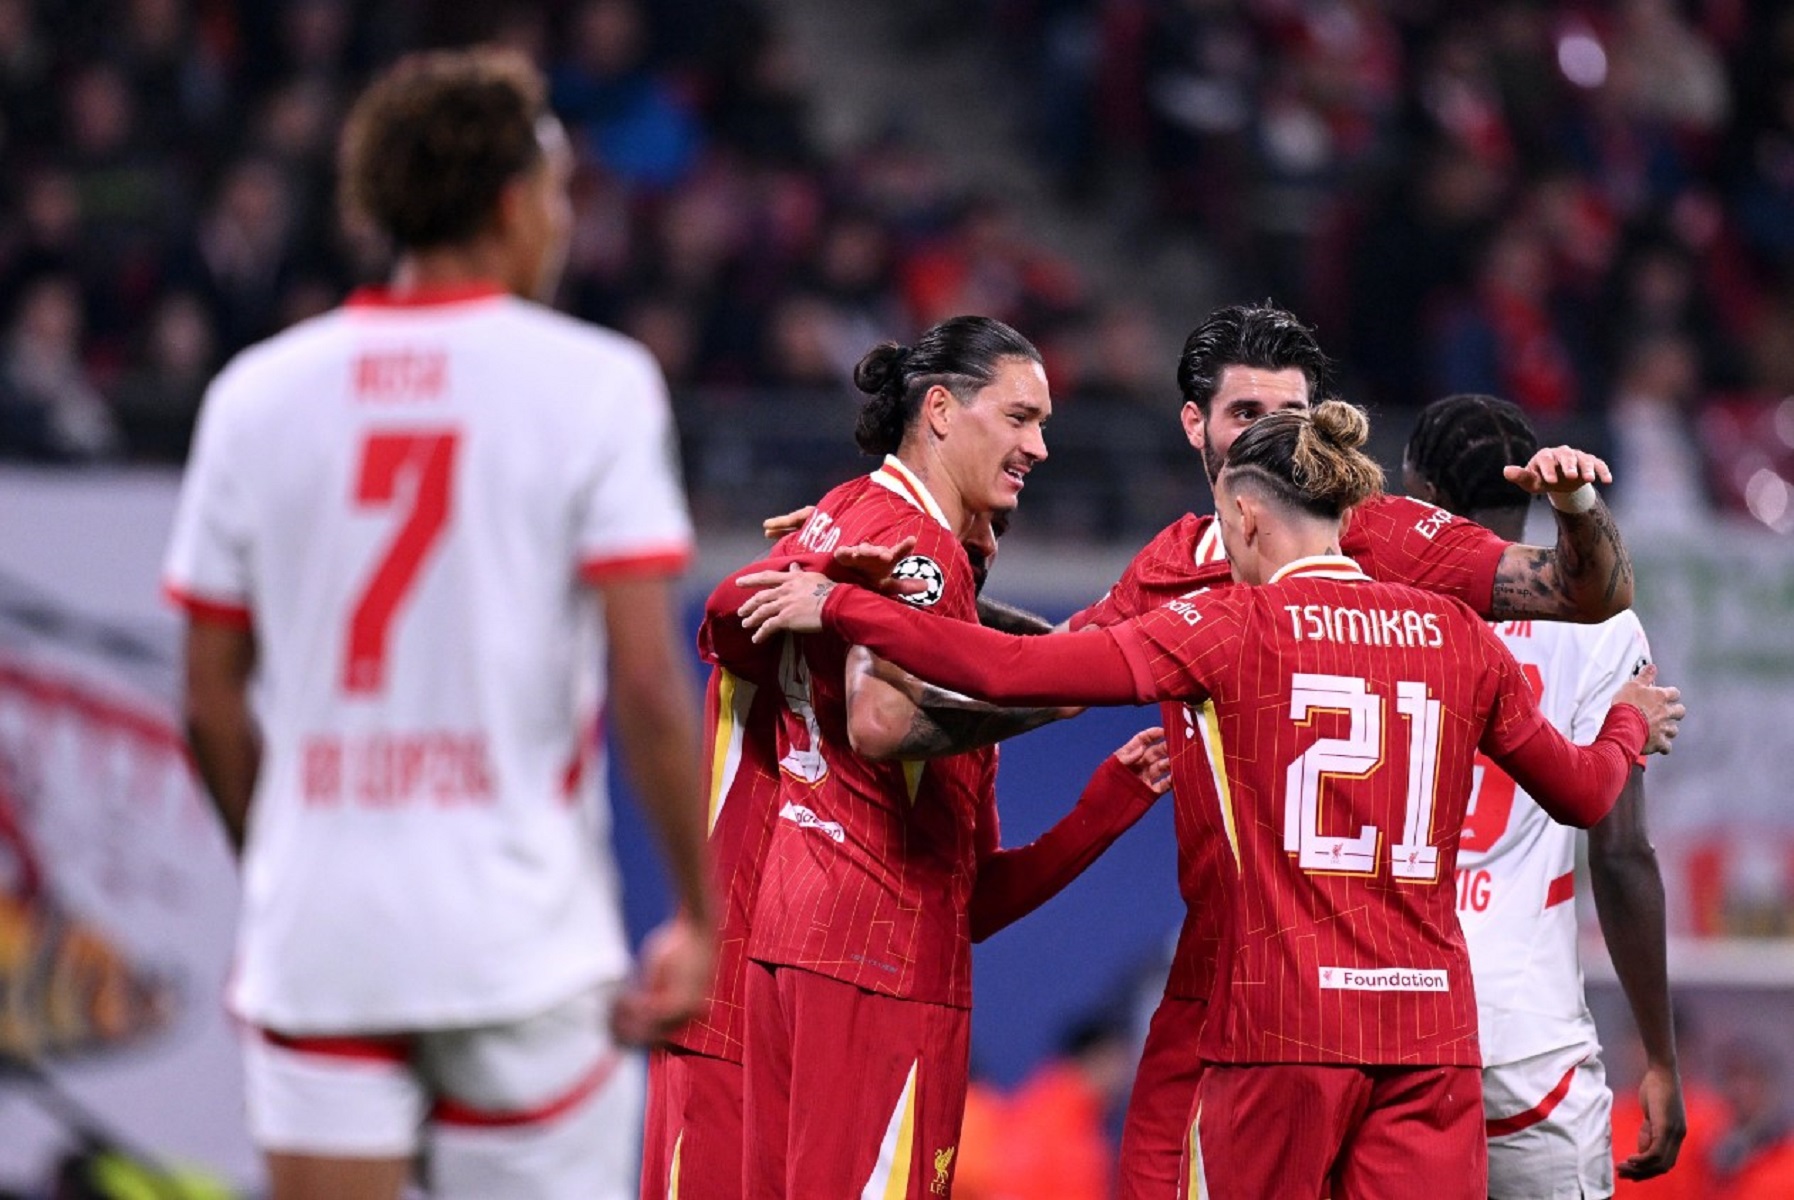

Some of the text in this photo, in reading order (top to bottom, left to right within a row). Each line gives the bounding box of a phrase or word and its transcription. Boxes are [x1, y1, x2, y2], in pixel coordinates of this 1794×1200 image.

[342, 428, 463, 694] 7
[1284, 605, 1444, 648] TSIMIKAS
[1284, 672, 1444, 883] 21
[1344, 972, 1443, 987] Foundation
